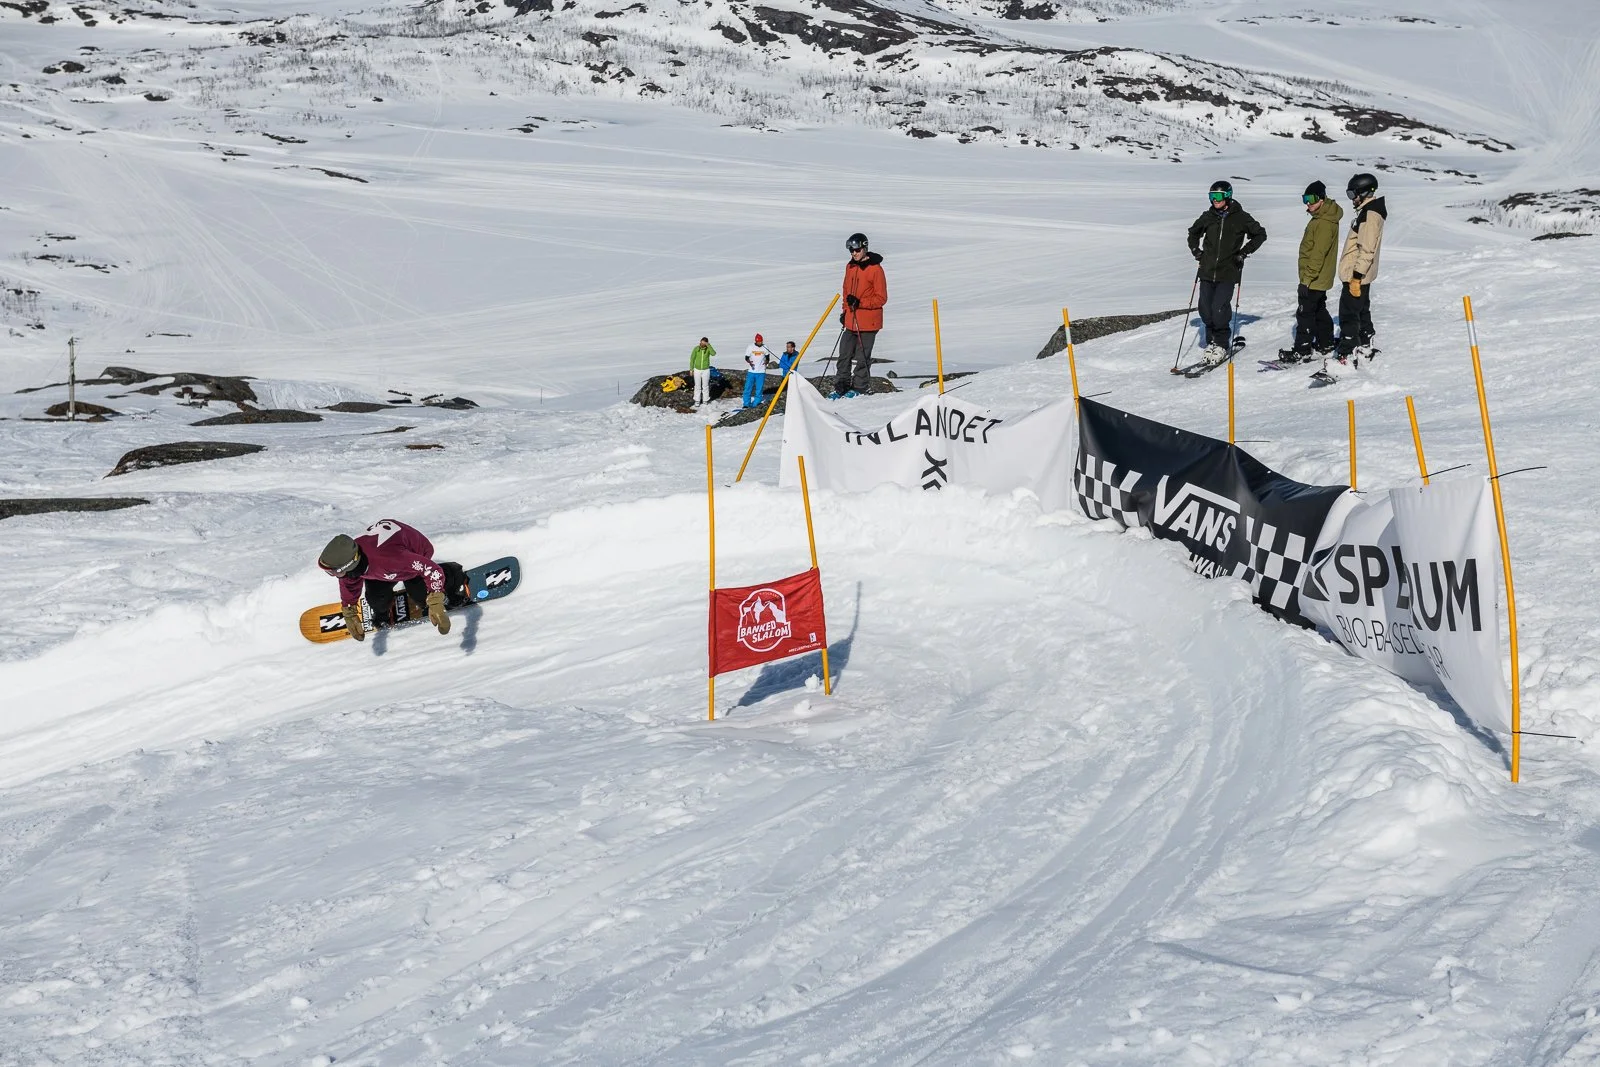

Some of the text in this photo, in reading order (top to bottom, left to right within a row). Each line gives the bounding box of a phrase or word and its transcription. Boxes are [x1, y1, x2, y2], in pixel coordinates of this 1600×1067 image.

[1153, 474, 1241, 553] VANS
[395, 595, 407, 622] VANS
[740, 620, 777, 638] BANKED
[752, 625, 789, 643] SLALOM
